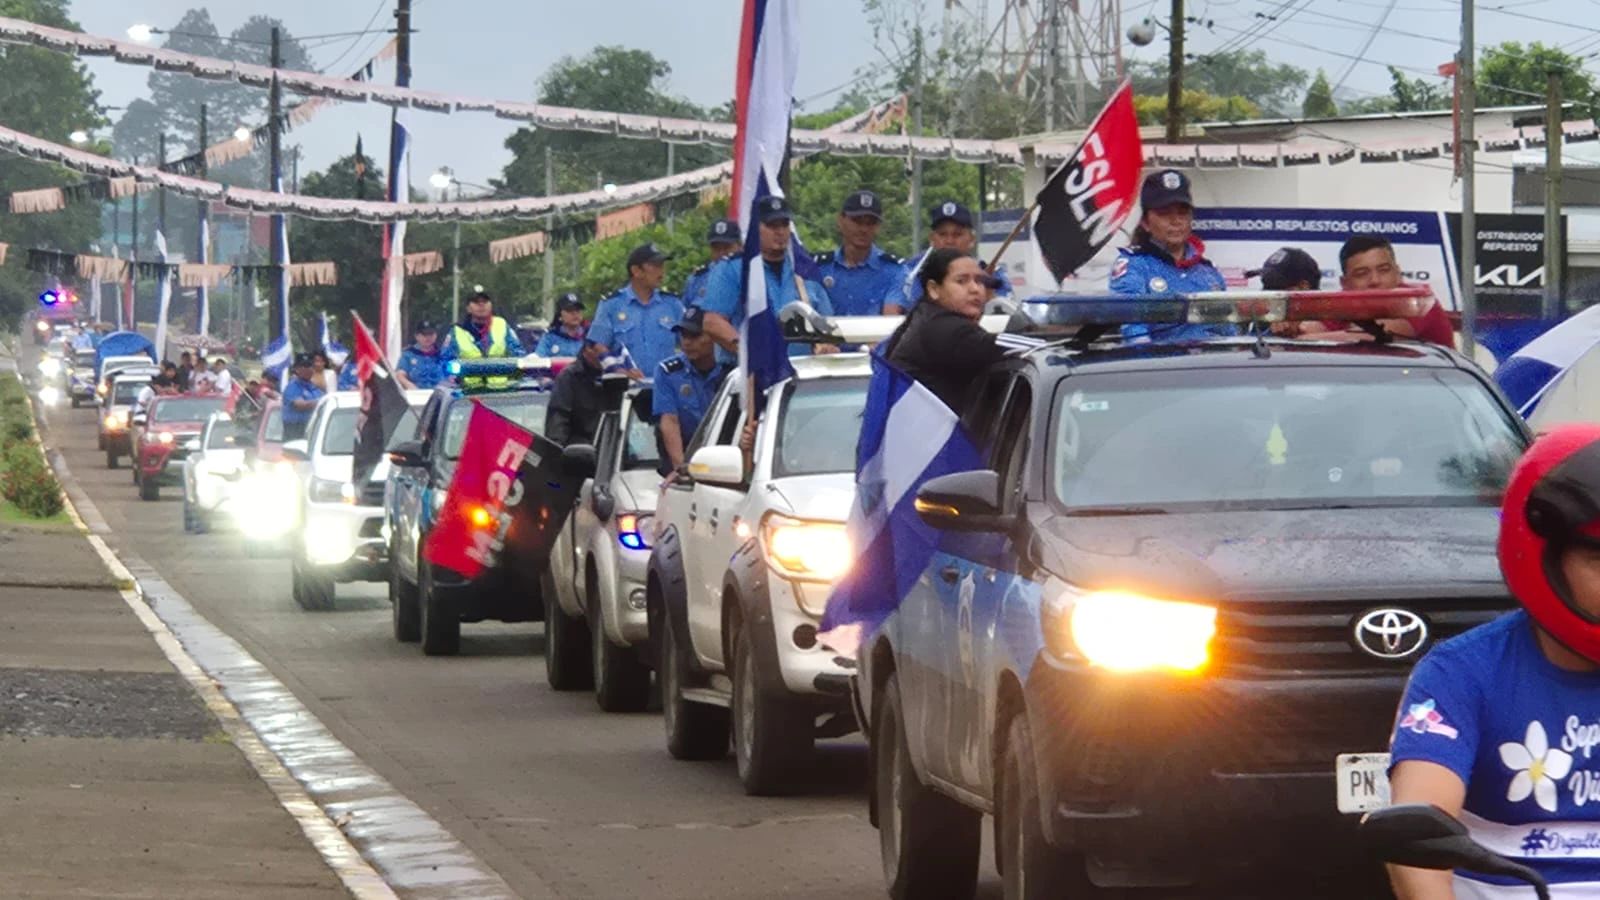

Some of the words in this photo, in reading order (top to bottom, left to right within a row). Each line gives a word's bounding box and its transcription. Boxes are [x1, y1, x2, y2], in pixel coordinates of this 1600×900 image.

[1065, 131, 1128, 247] FSLN
[1191, 219, 1273, 231] DISTRIBUIDOR
[1275, 219, 1349, 232] REPUESTOS
[1351, 221, 1418, 234] GENUINOS
[1476, 231, 1544, 241] DISTRIBUIDOR
[1482, 242, 1539, 252] REPUESTOS
[1350, 770, 1376, 797] PN
[1568, 770, 1600, 807] Vi
